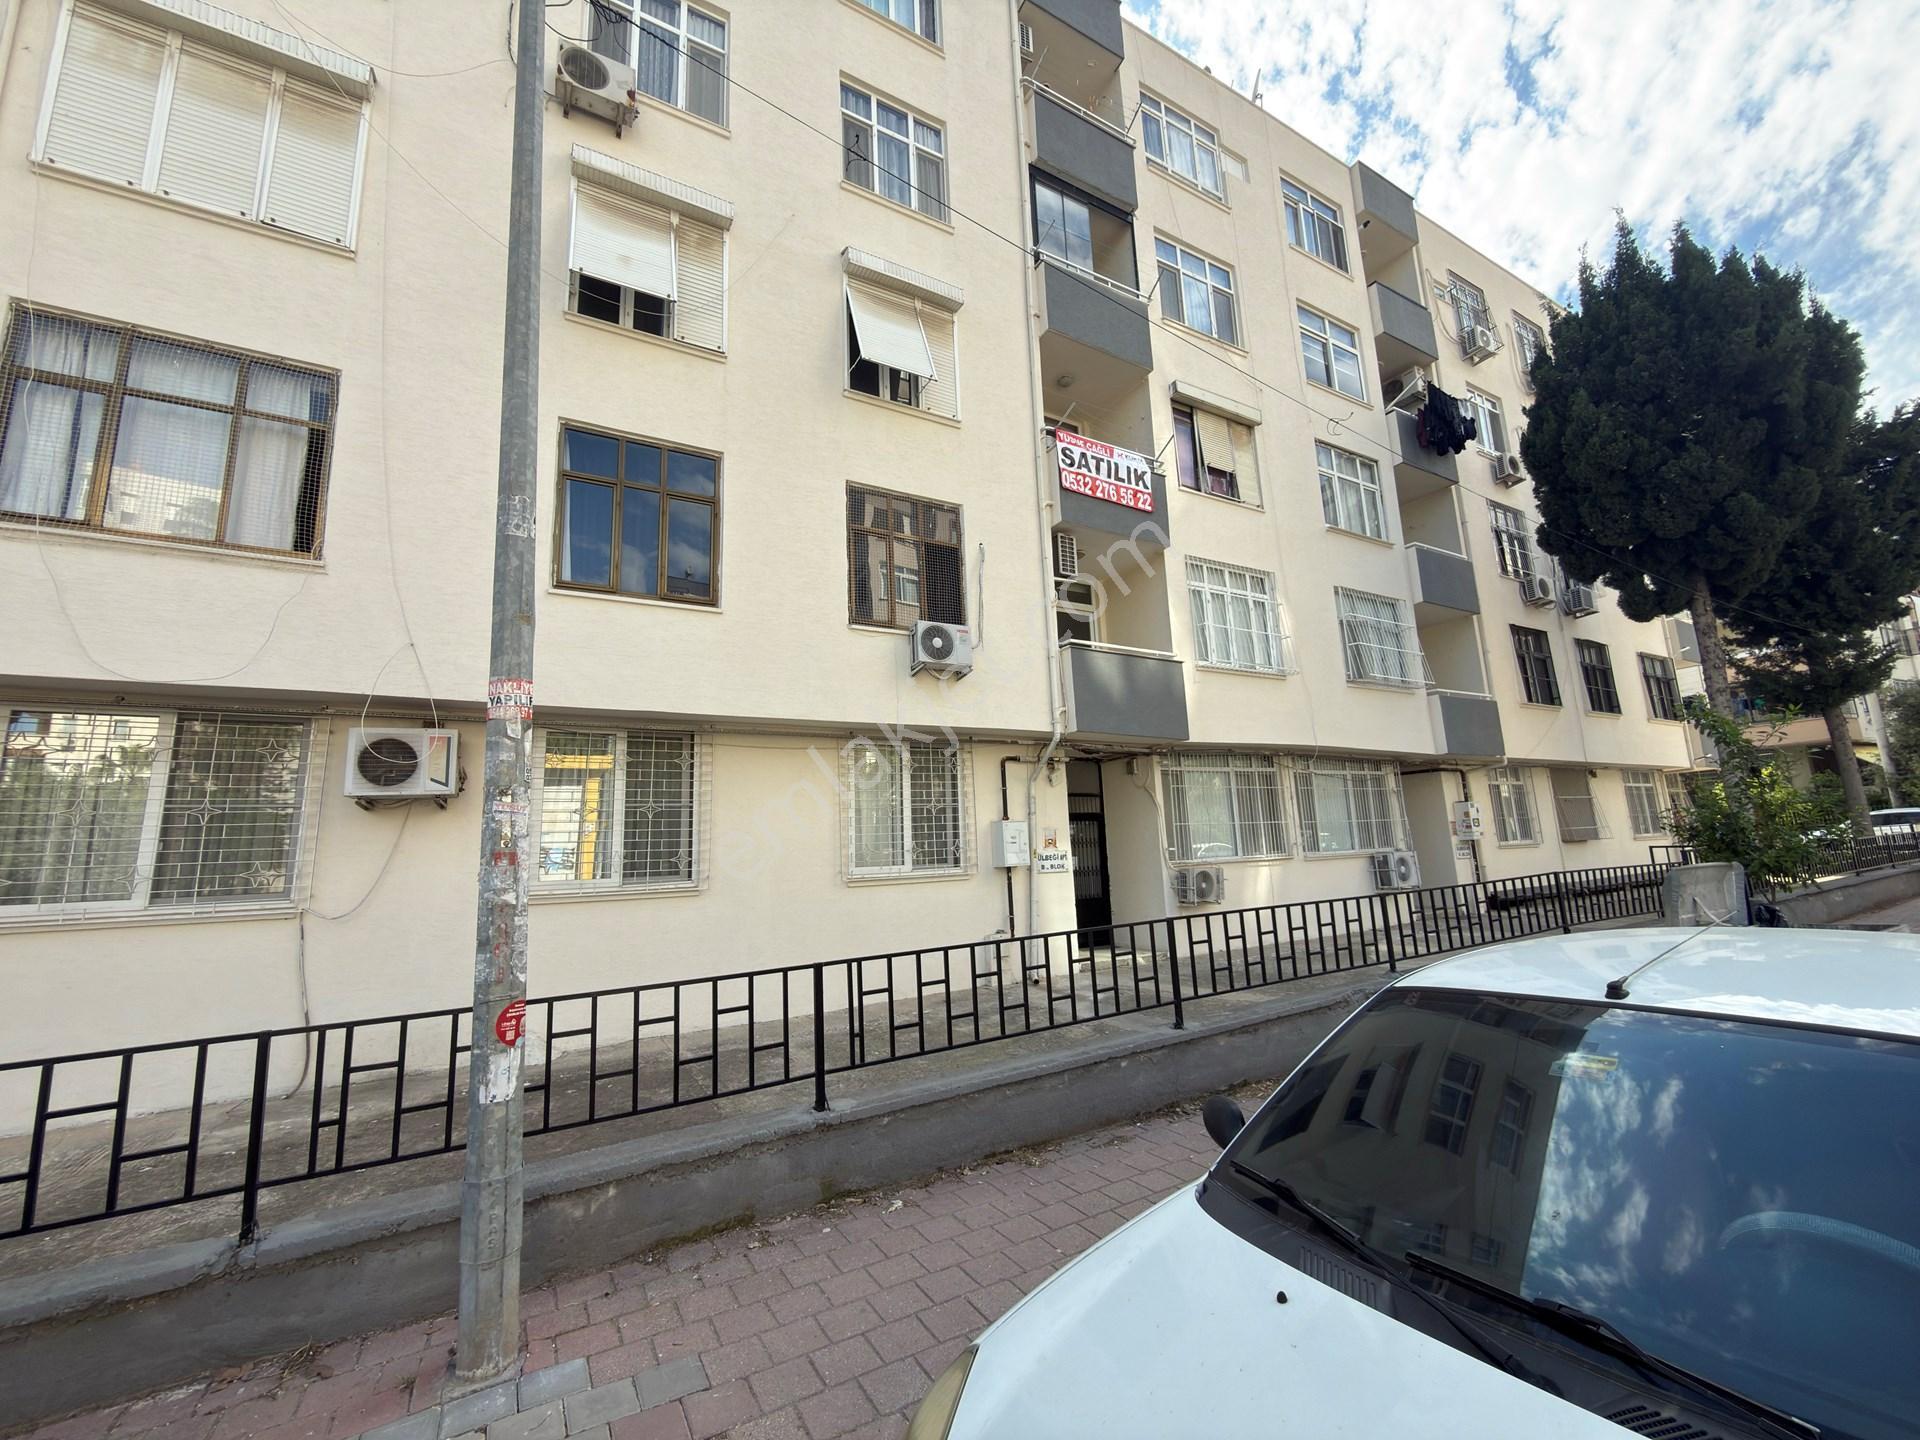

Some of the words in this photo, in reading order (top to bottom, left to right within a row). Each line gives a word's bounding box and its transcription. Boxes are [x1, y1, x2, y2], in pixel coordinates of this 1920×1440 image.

[1060, 446, 1150, 491] SATILIK
[1061, 471, 1093, 496] 0532
[1095, 480, 1118, 502] 276
[1120, 488, 1135, 506] 56
[1137, 493, 1152, 510] 22
